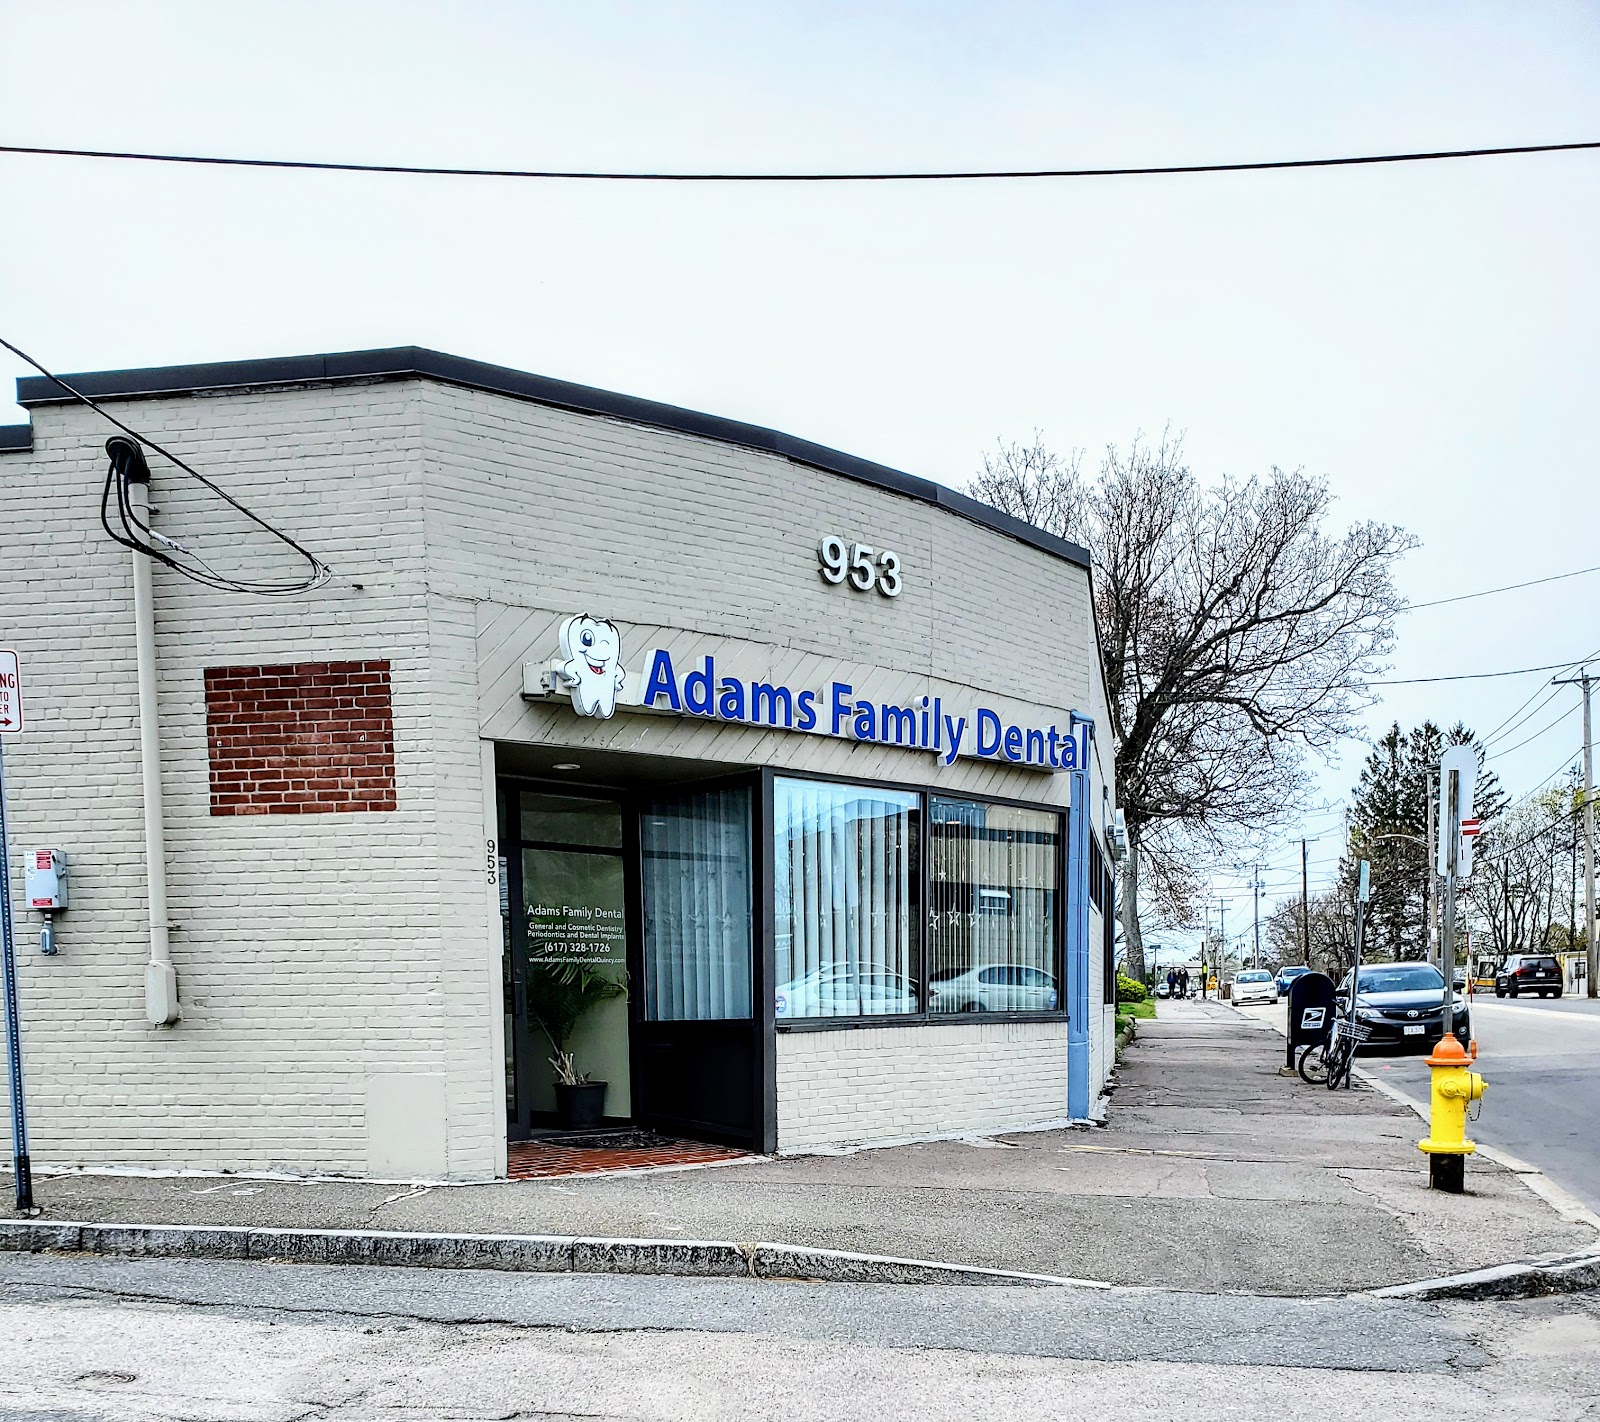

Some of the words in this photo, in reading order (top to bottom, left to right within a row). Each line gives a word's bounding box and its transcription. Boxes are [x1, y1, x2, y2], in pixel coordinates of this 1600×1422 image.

[819, 535, 904, 598] 953
[642, 648, 818, 731] Adams
[830, 680, 967, 768] Family
[975, 706, 1090, 772] Dental
[486, 839, 497, 885] 953
[527, 904, 561, 916] Adams
[562, 905, 593, 920] Family
[594, 907, 624, 919] Dental
[527, 930, 566, 938] Periodontics
[566, 931, 579, 939] and
[579, 931, 600, 939] Dental
[600, 932, 625, 941] Implants
[528, 922, 554, 930] General
[554, 923, 567, 931] and
[567, 923, 596, 932] Cosmetic
[596, 924, 623, 934] Dentistry
[544, 942, 568, 954] (617)
[569, 942, 611, 953] 328-1726
